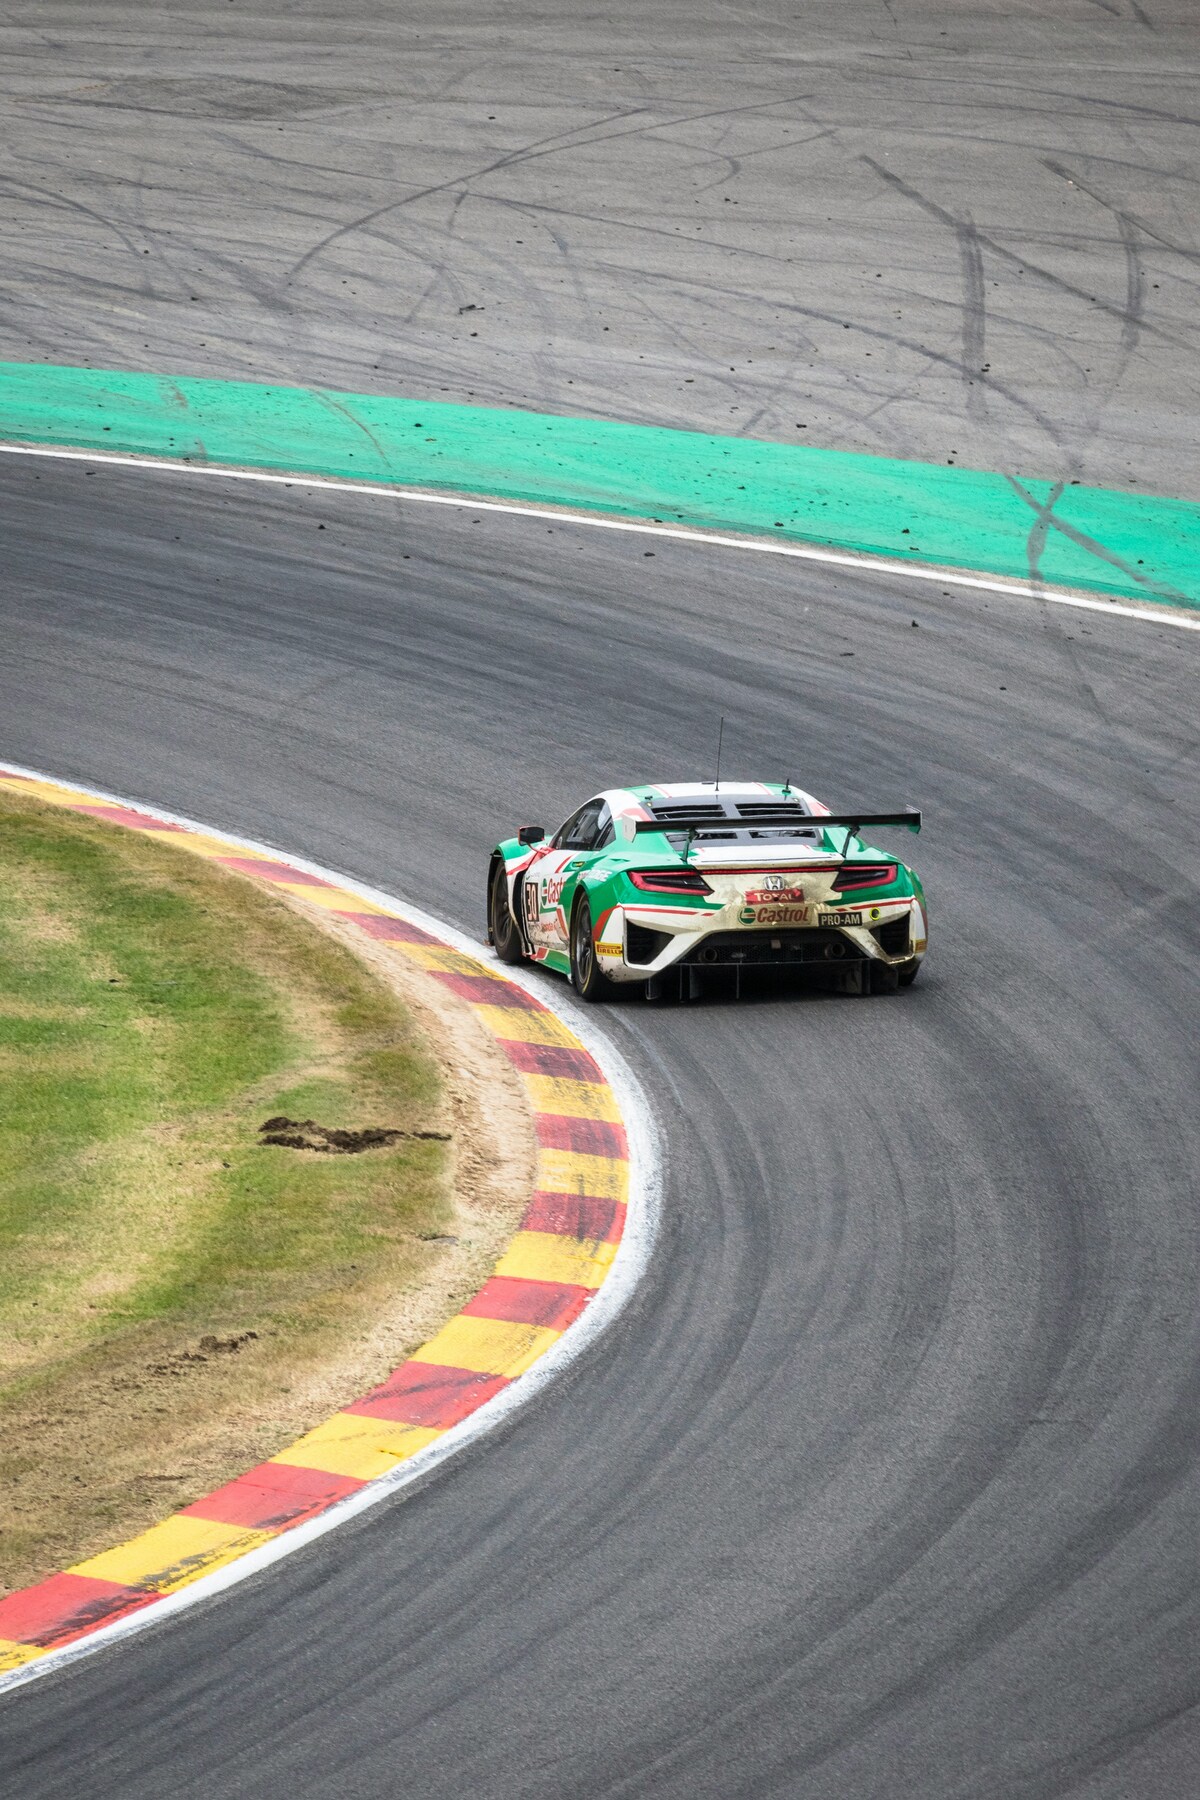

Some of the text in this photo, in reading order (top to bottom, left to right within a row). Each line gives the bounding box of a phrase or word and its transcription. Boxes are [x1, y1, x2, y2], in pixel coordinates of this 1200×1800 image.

[526, 884, 537, 921] 30
[753, 892, 794, 902] TOTAL
[757, 906, 809, 923] Castrol
[821, 914, 861, 926] PRO-AM
